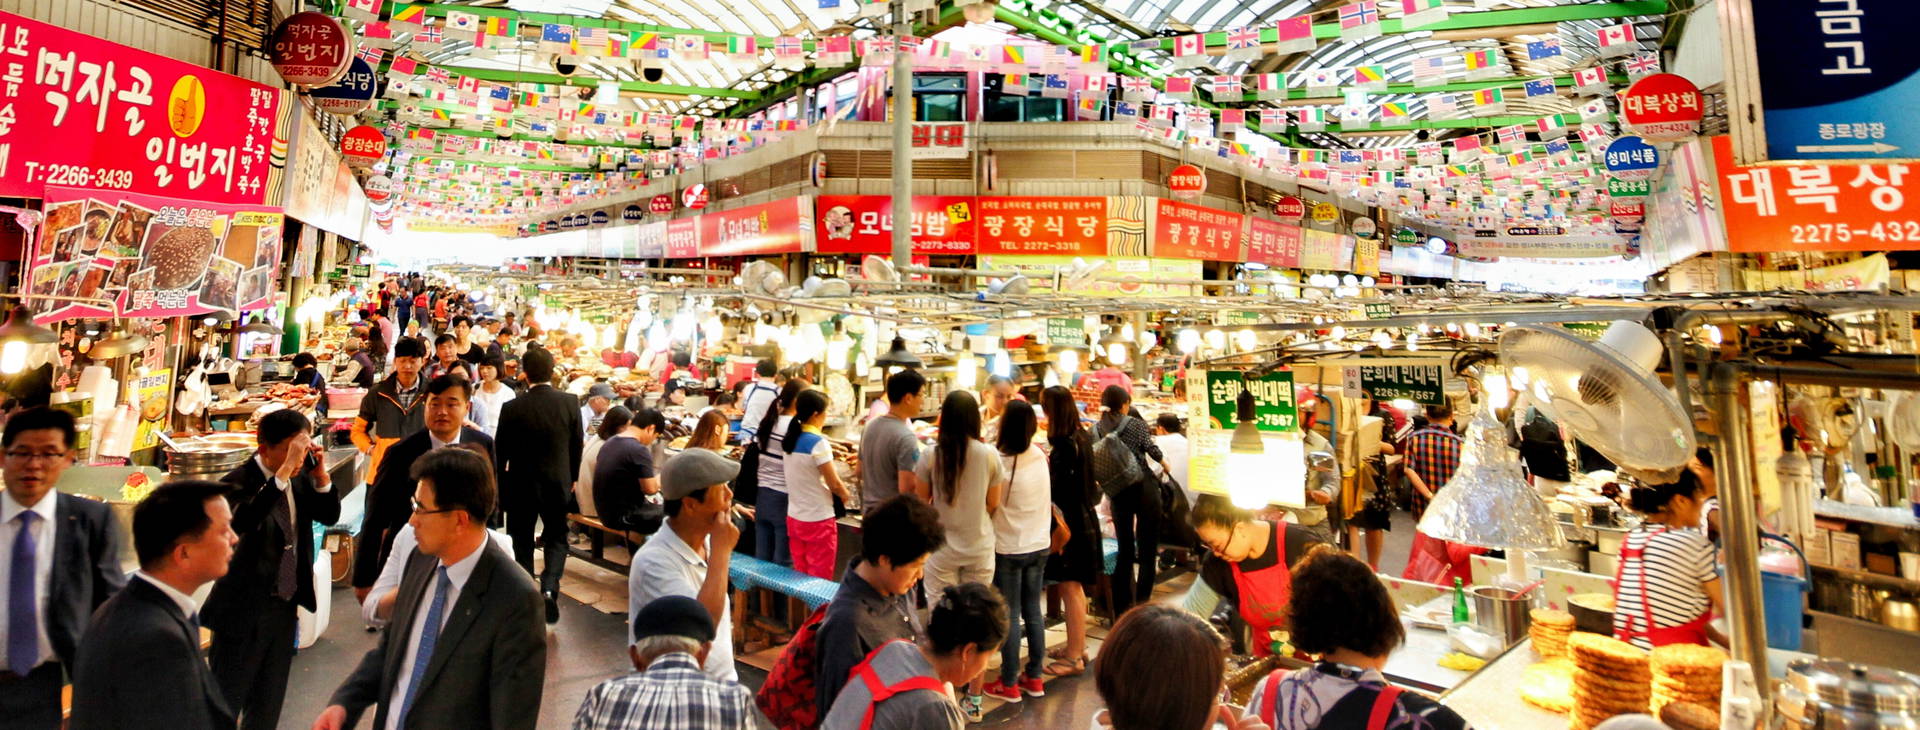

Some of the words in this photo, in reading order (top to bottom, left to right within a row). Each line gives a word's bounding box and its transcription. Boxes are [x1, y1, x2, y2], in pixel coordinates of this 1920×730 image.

[287, 24, 332, 40] 먹자골
[1815, 0, 1872, 75] 금고
[275, 42, 340, 64] 일번지
[35, 46, 154, 137] 먹자골
[1626, 91, 1698, 115] 대복상회
[1819, 122, 1886, 140] 종로광장
[345, 137, 385, 154] 광장순대
[146, 137, 236, 193] 일번지
[1607, 148, 1655, 166] 성미식품
[1726, 164, 1910, 216] 대복상
[983, 216, 1099, 238] 광장식당
[1169, 222, 1232, 250] 광장식당
[1374, 387, 1436, 400] 2263-7567
